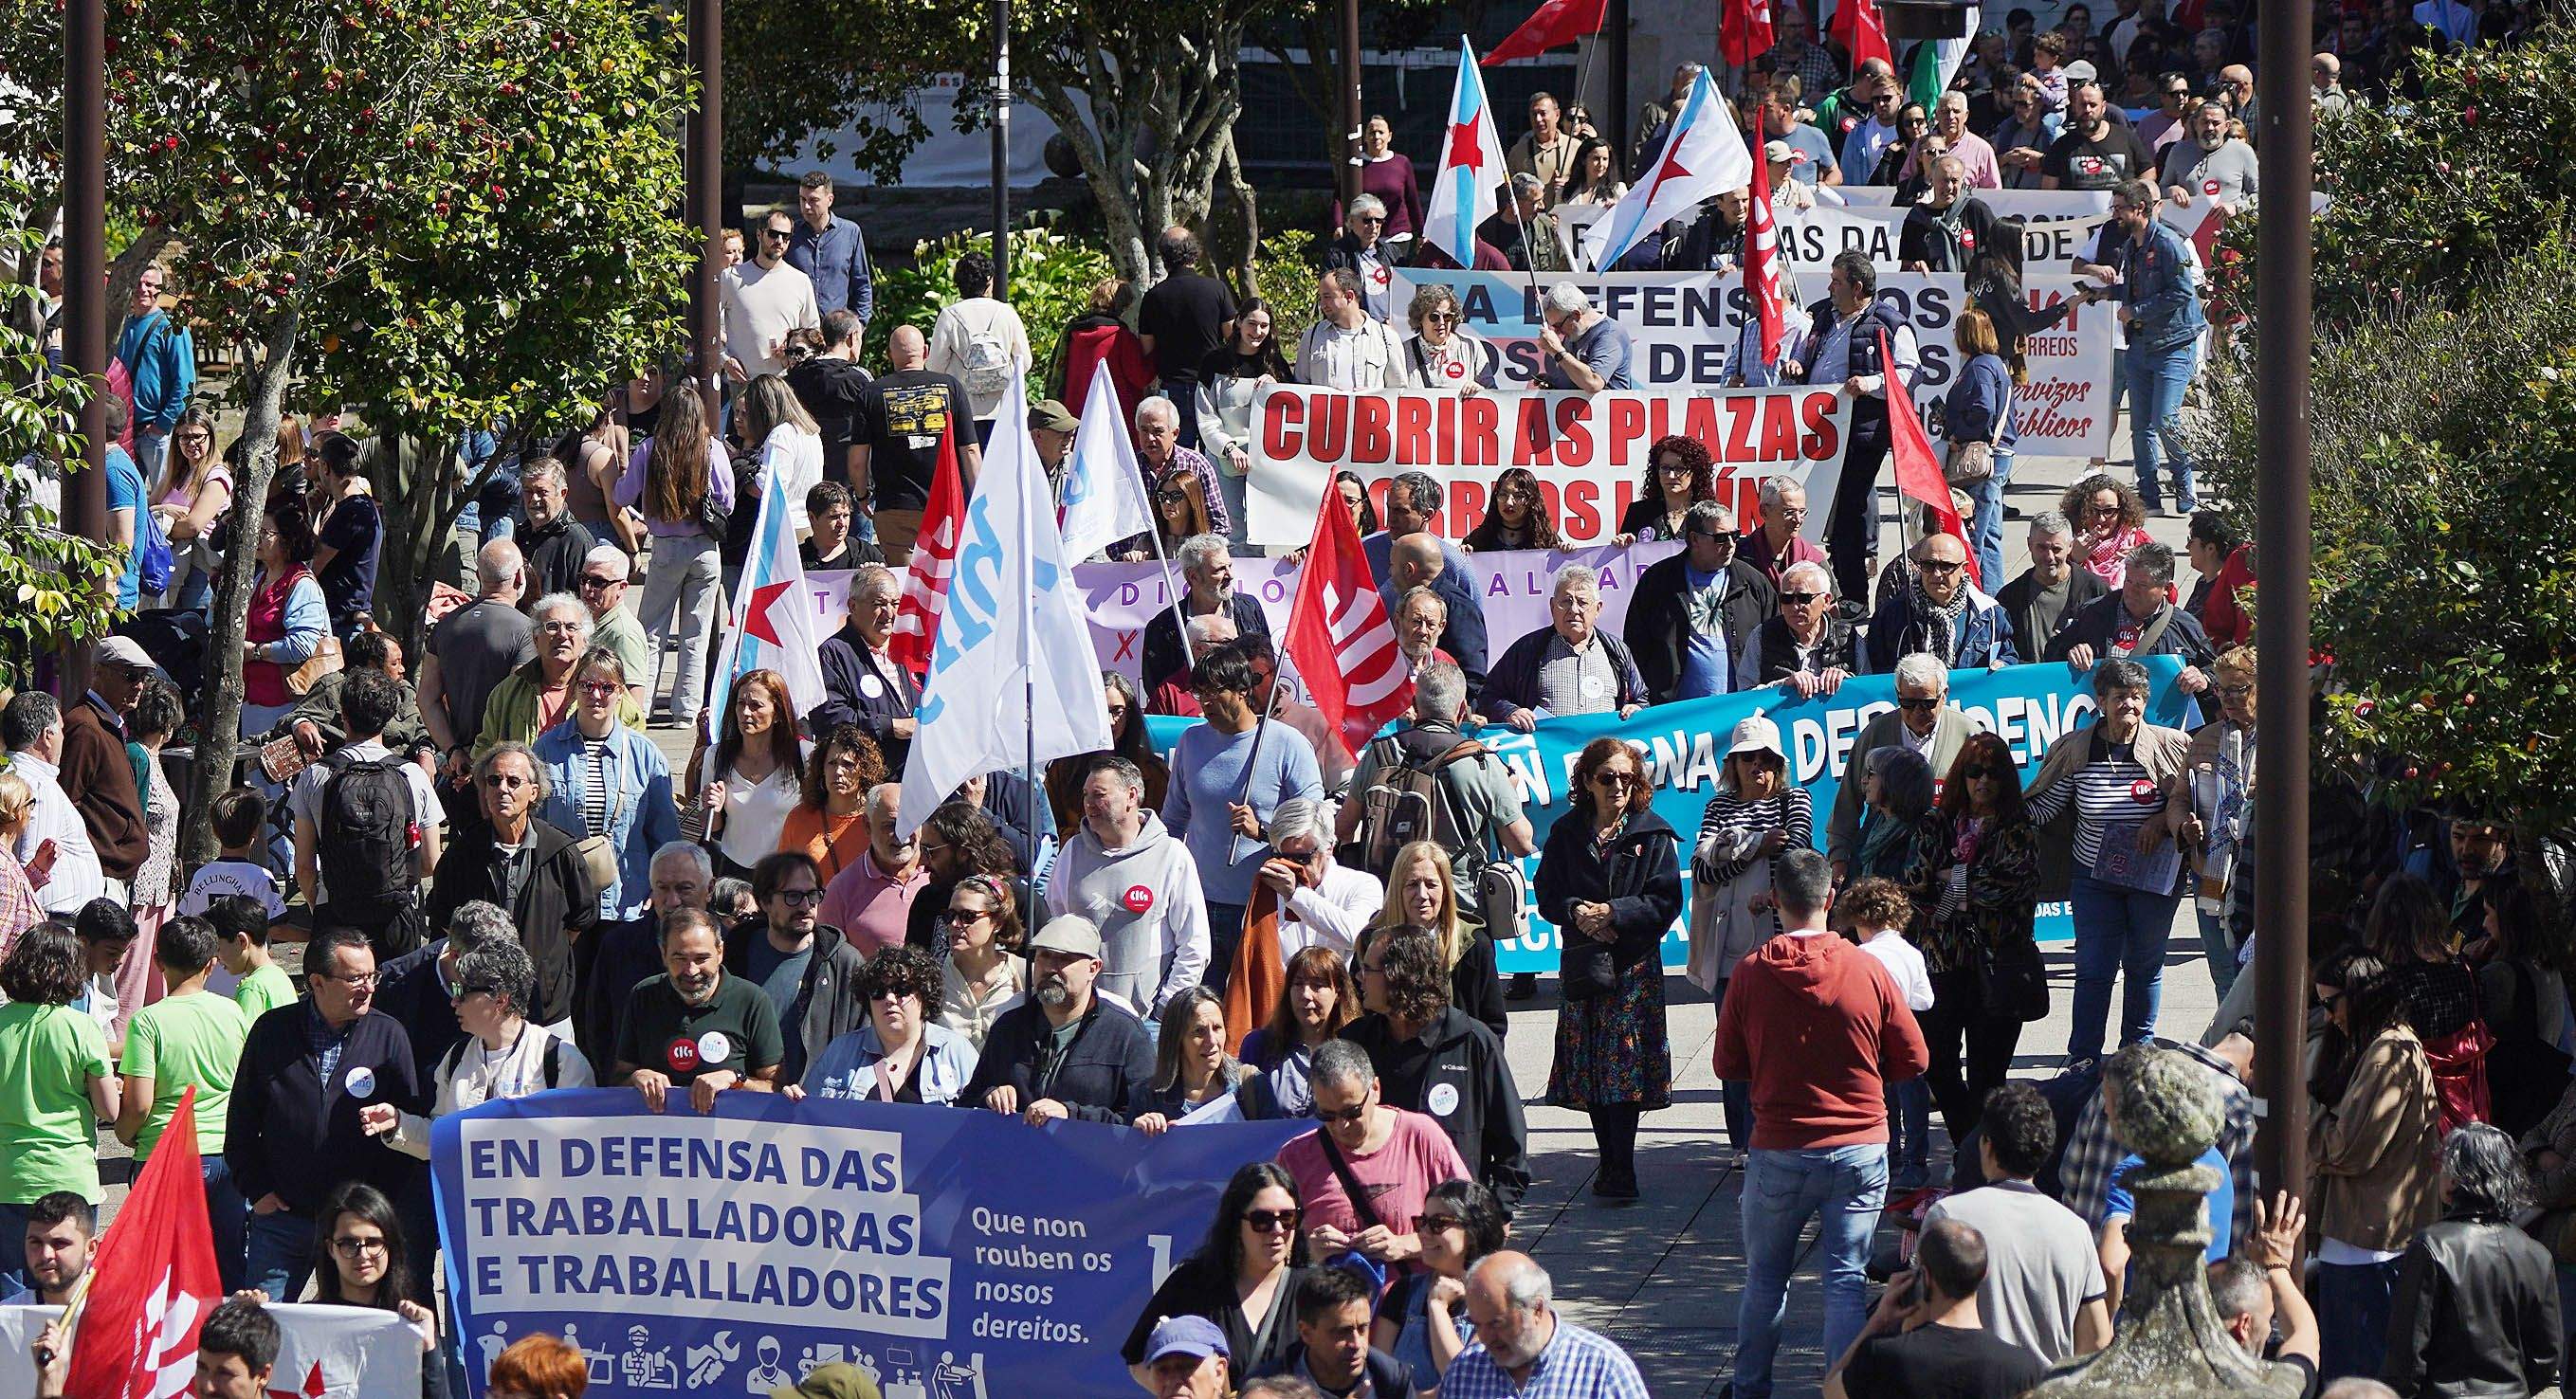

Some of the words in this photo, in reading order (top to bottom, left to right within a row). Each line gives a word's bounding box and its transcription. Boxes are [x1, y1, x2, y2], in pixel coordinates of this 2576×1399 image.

[2026, 229, 2073, 261] DE
[1263, 391, 1499, 466] CUBRIR
[1512, 396, 1594, 467] AS
[194, 874, 246, 897] BELLINGHA
[1129, 889, 1149, 902] CIG
[673, 1045, 693, 1059] CIG
[470, 1138, 540, 1178] EN
[560, 1136, 788, 1184] DEFENSA
[801, 1146, 897, 1193] DAS
[470, 1196, 914, 1256] TRABALLADORAS
[972, 1207, 1025, 1236] Que
[1033, 1216, 1087, 1238] non
[976, 1244, 1074, 1270] rouben
[1082, 1251, 1113, 1273] os
[476, 1256, 502, 1296] E
[518, 1254, 943, 1320] TRABALLADORES
[975, 1280, 1053, 1305] nosos
[972, 1312, 1089, 1344] dereitos.
